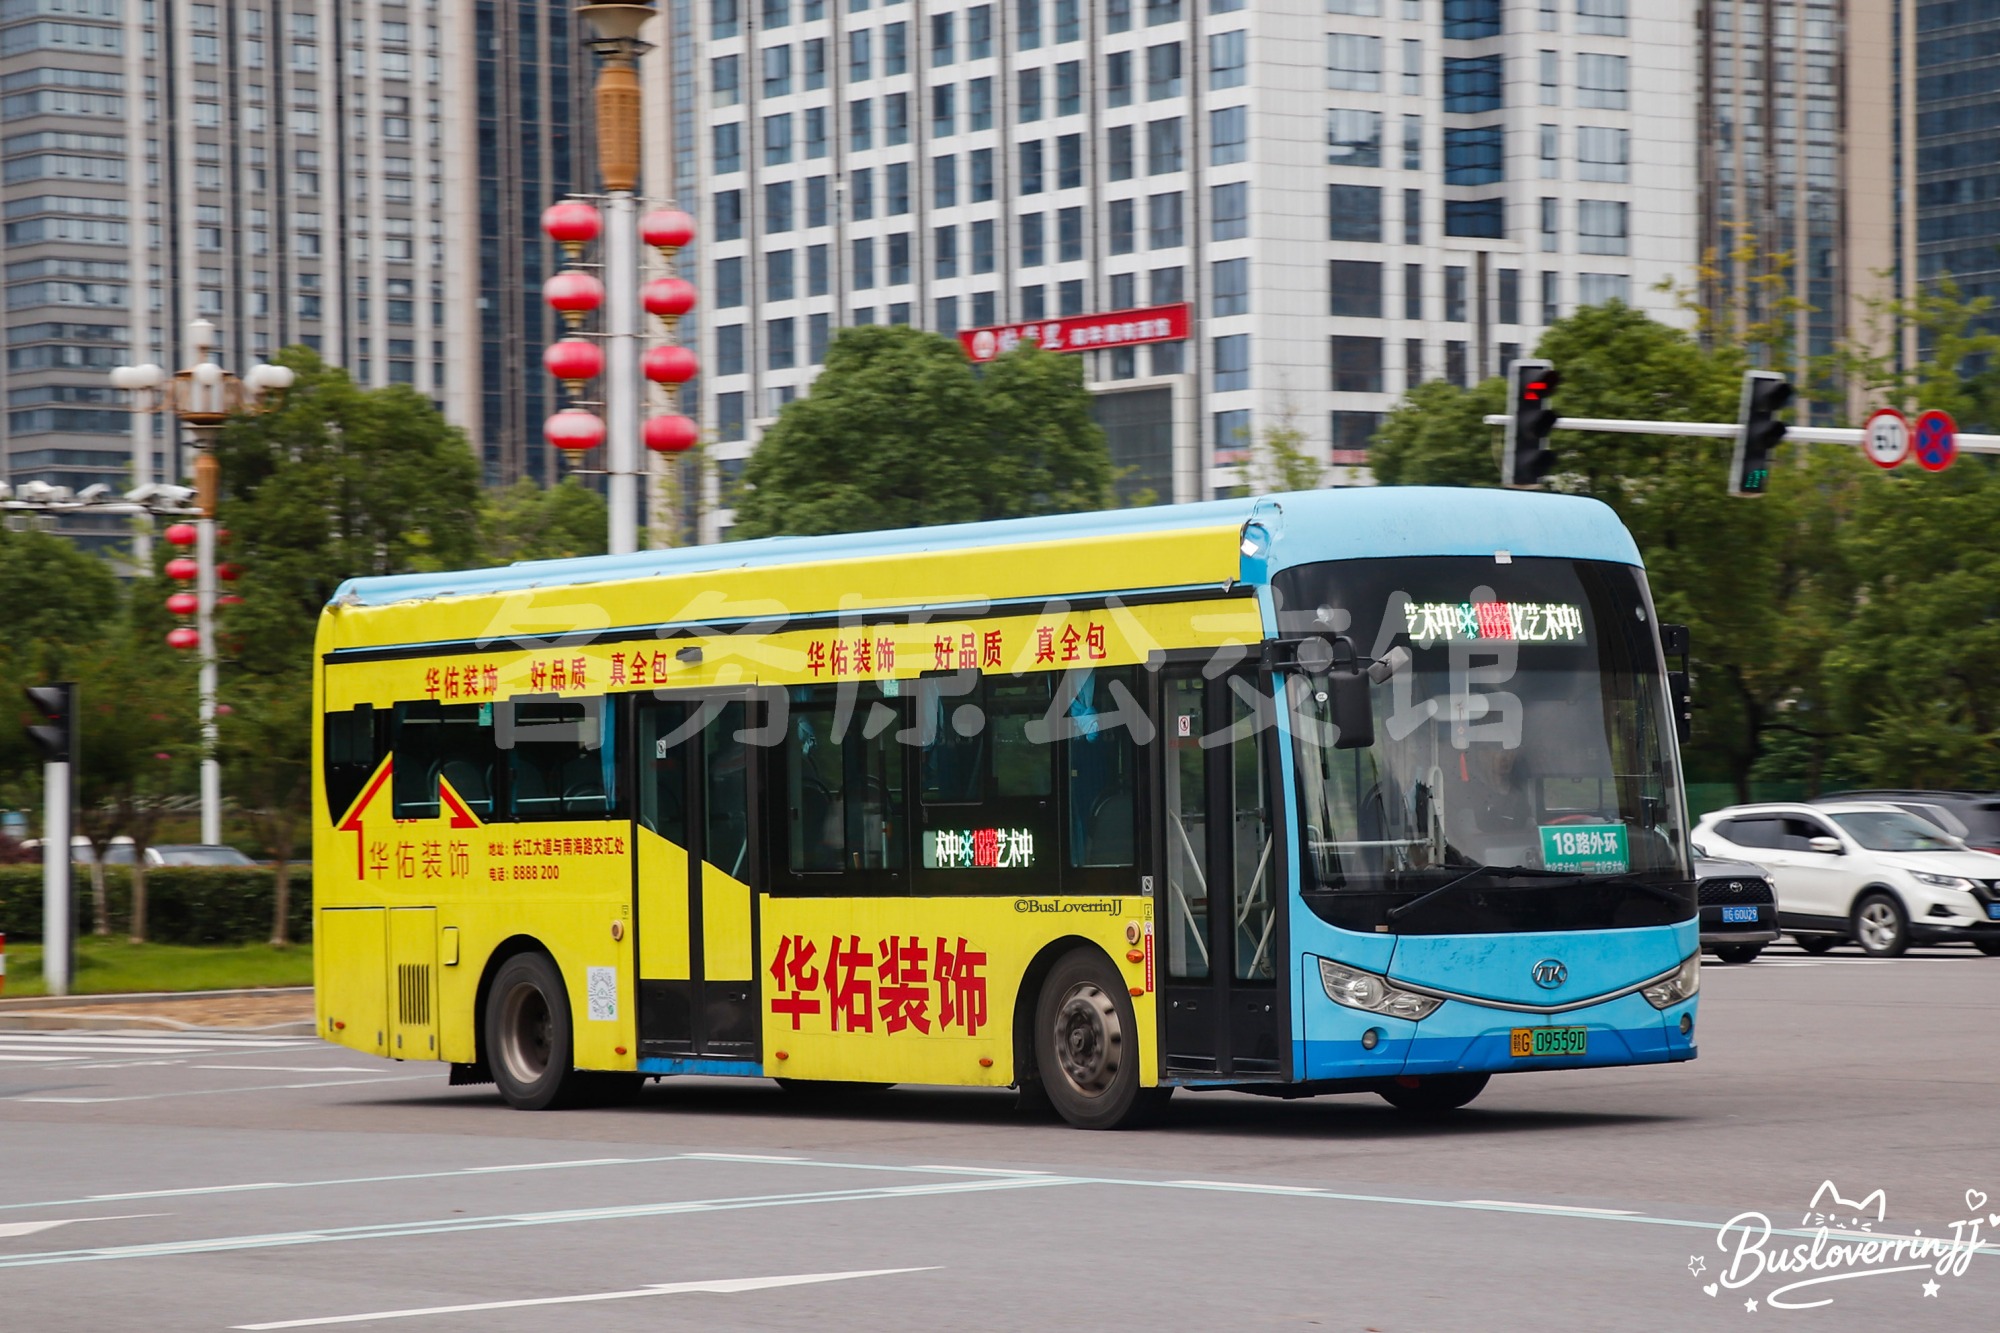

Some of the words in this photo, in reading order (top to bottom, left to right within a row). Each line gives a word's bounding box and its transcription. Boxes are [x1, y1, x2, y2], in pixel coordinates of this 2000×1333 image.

[1404, 602, 1461, 640] 艺术中
[807, 637, 895, 677] 华佑装饰
[934, 630, 1003, 671] 好品质
[1034, 622, 1107, 664] 真全包
[424, 664, 498, 700] 华佑装饰
[530, 657, 587, 692] 好品质
[609, 650, 668, 686] 真全包
[369, 840, 470, 880] 华佑装饰
[513, 836, 624, 856] 长江大道与南海路交汇处
[997, 828, 1035, 868] 艺术中
[1552, 831, 1618, 855] 18路外环
[513, 865, 537, 880] 8888
[541, 865, 559, 880] 200
[769, 934, 987, 1037] 华佑装饰
[1536, 1031, 1585, 1052] 09559D
